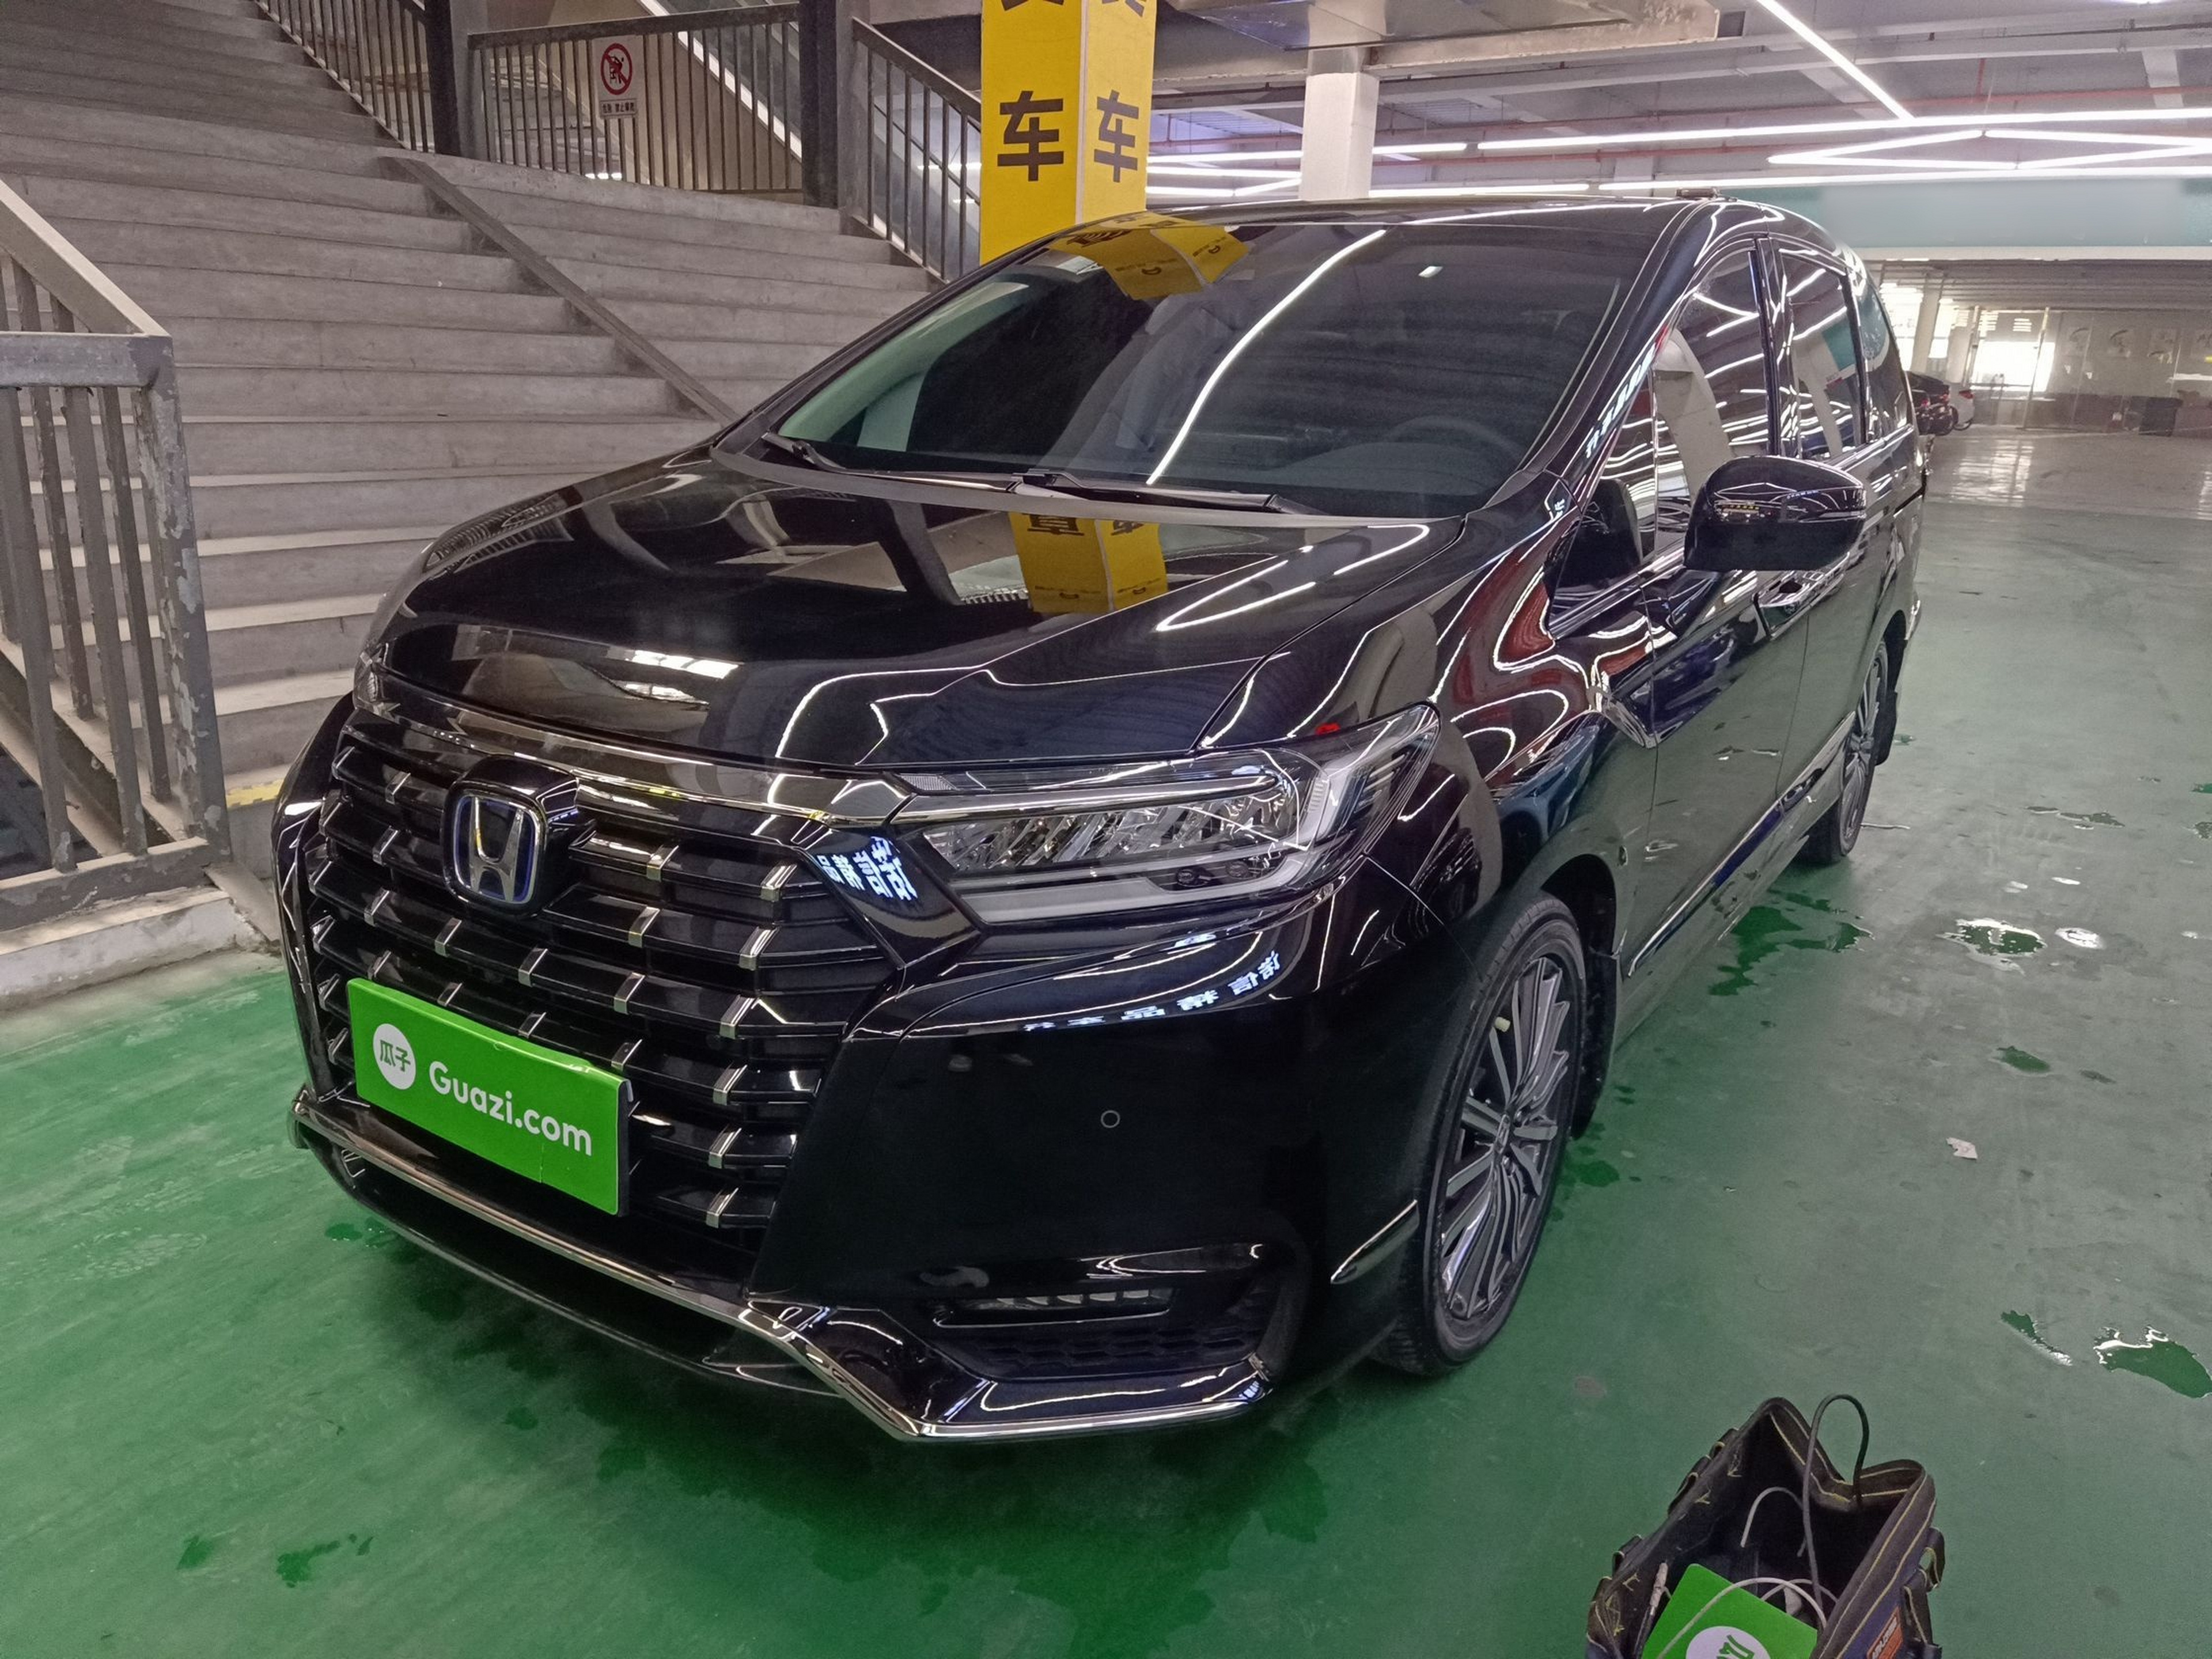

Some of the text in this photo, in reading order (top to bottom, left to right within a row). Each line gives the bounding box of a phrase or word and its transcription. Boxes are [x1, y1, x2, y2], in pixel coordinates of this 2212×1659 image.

[469, 796, 524, 903] H
[379, 1039, 411, 1073] 瓜子
[429, 1060, 592, 1157] Guazi.com
